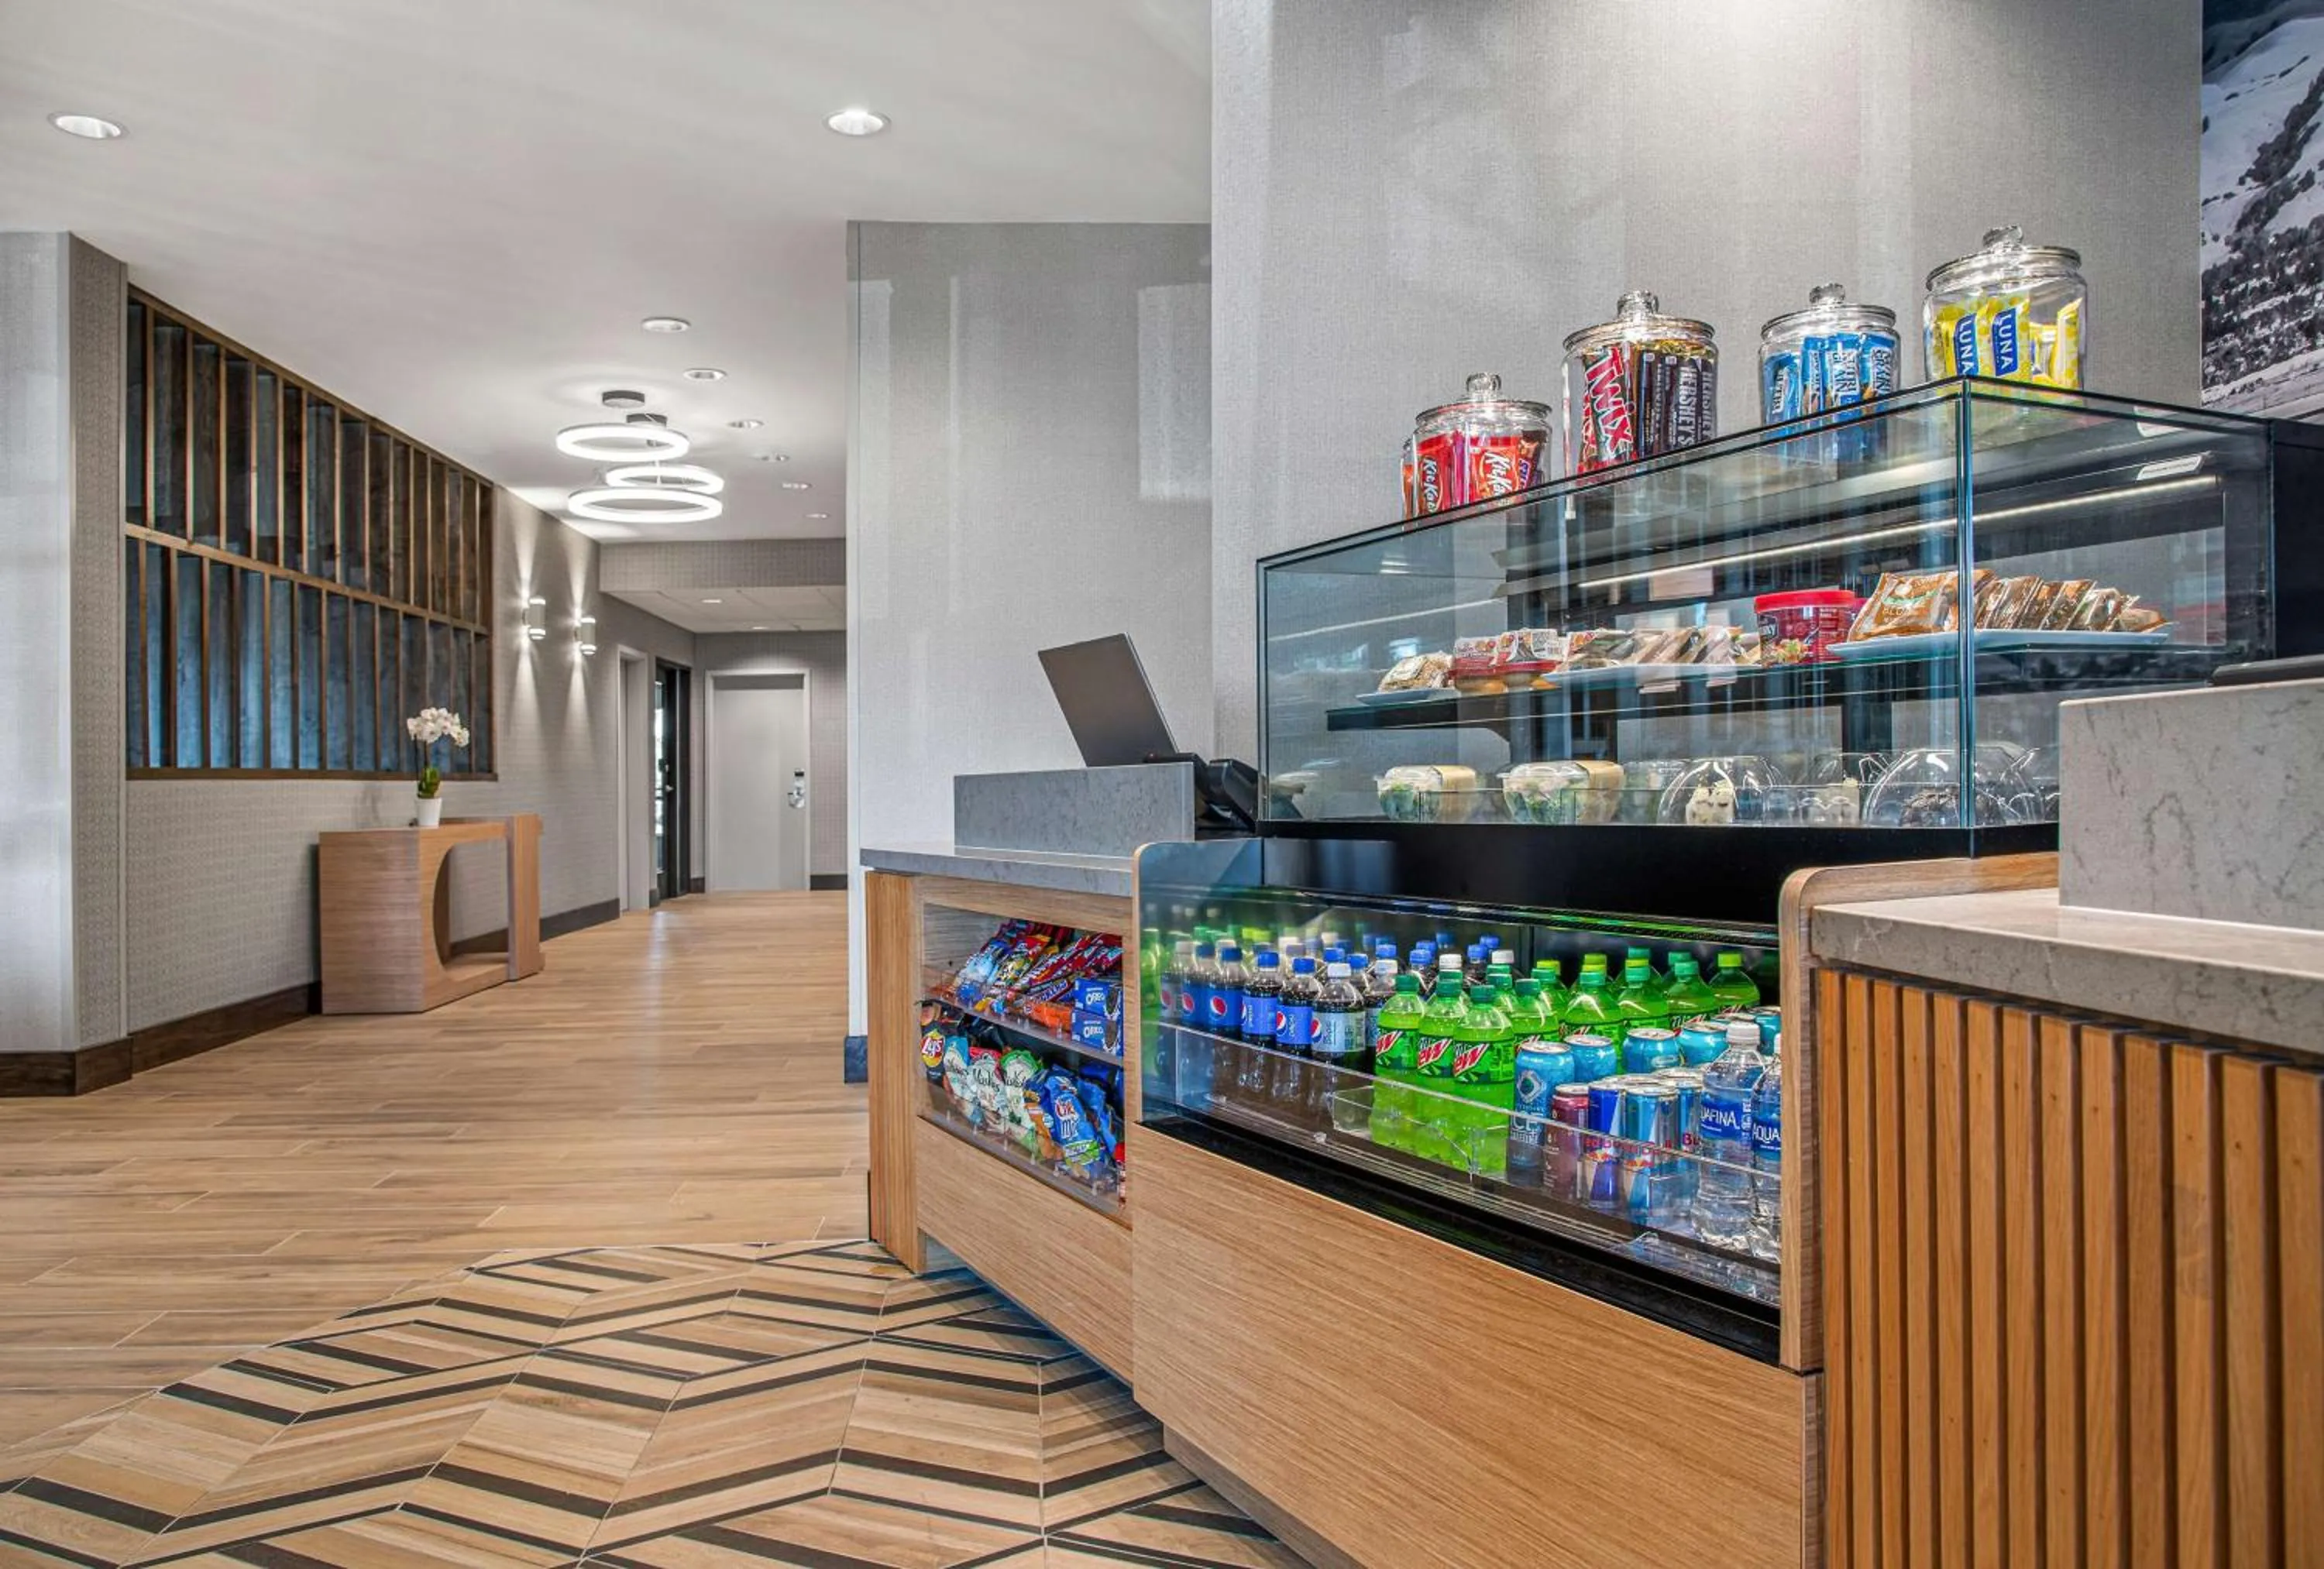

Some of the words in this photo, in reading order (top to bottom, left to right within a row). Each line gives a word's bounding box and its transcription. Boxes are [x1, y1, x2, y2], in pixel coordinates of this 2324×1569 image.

[1959, 320, 1975, 376] LUNA
[1999, 314, 2014, 369] LUNA
[1678, 366, 1698, 447] HERSHEY'S
[1483, 451, 1512, 496] KitKa
[1700, 1106, 1741, 1130] UAFINA
[1752, 1122, 1781, 1145] AQUA
